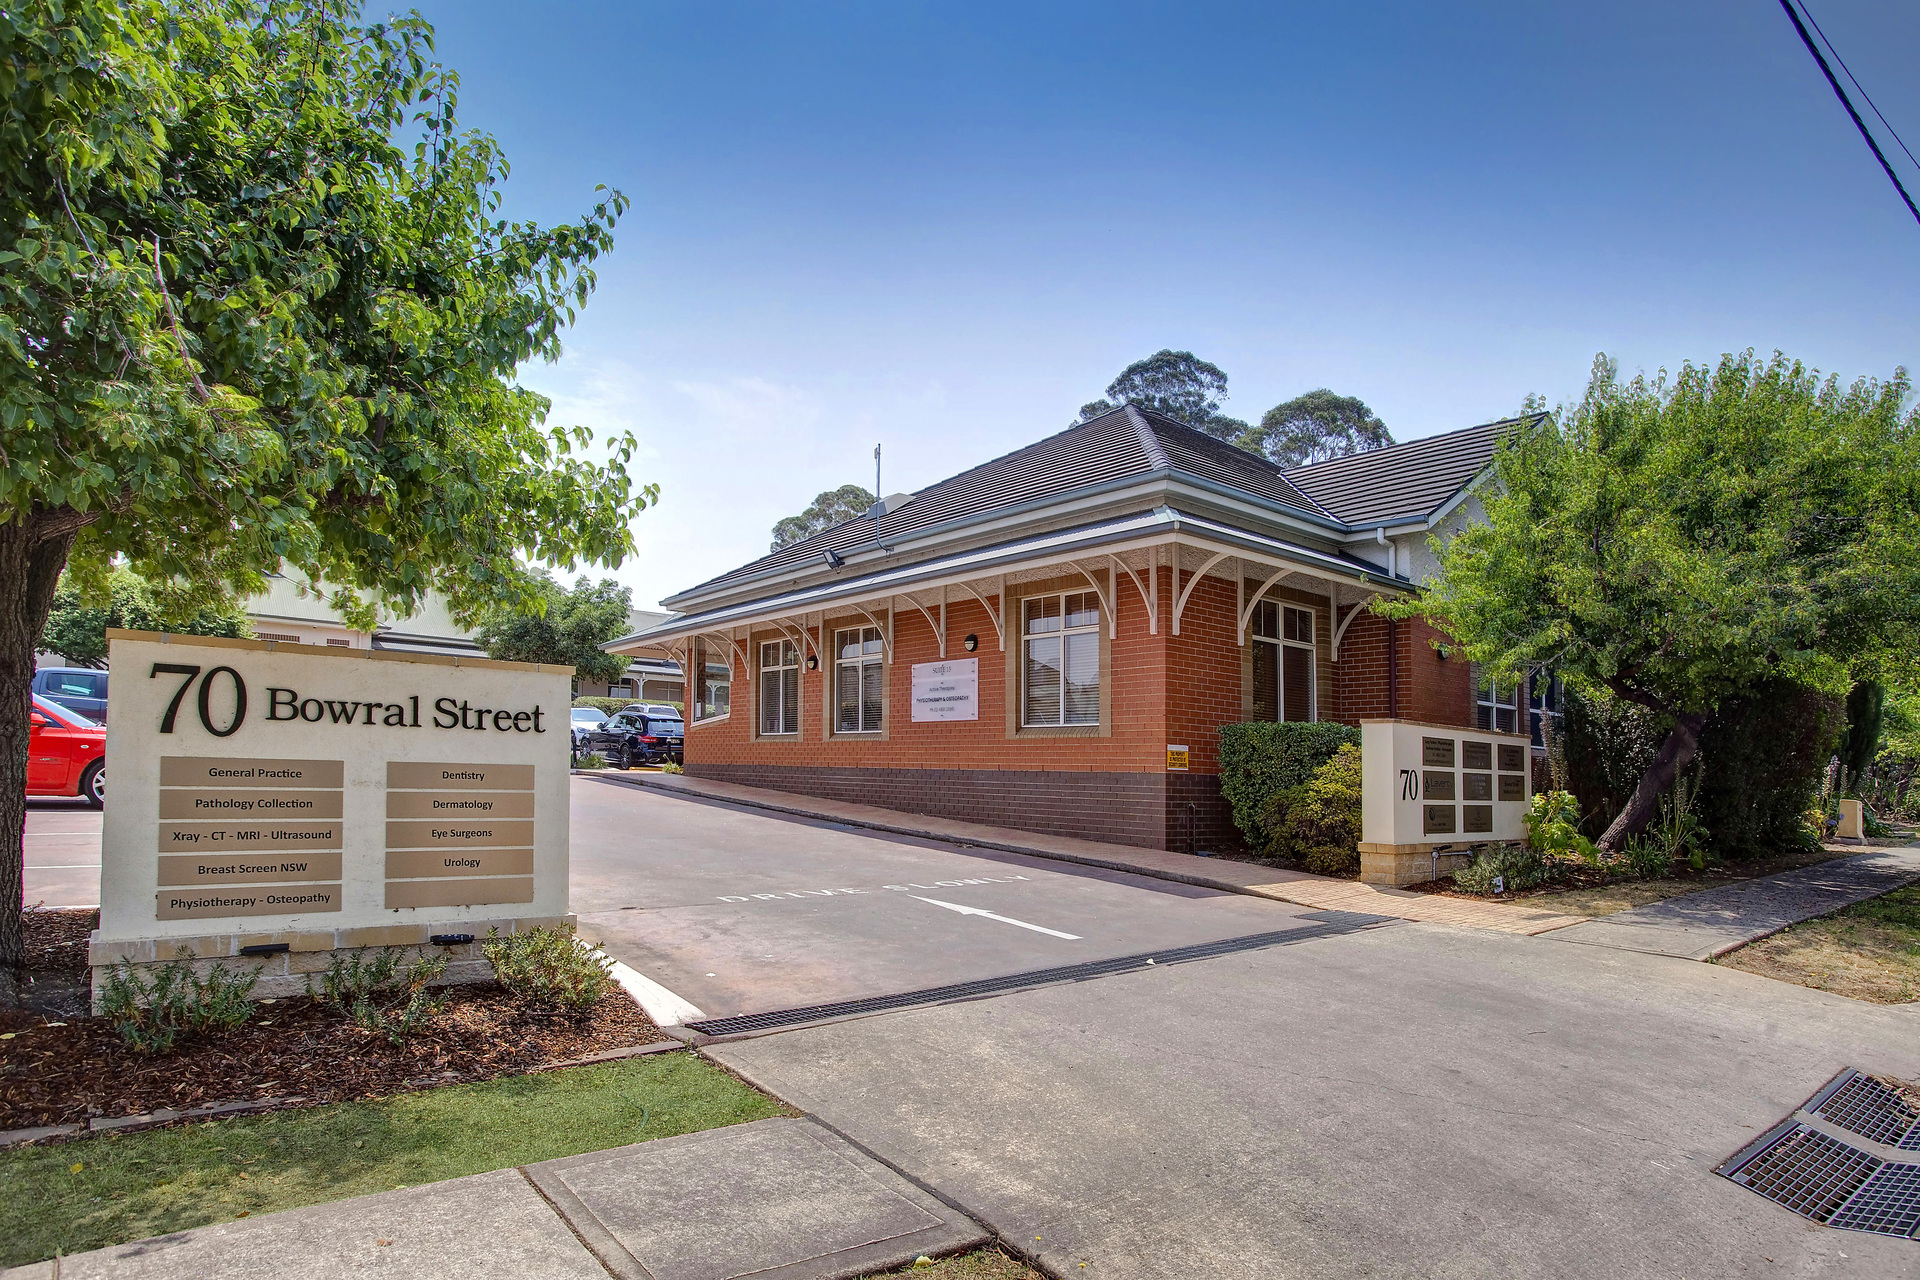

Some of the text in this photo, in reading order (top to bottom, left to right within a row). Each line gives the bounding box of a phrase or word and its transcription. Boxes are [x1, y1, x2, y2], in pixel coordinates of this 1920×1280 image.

[149, 662, 546, 737] 70 Bowral Street
[208, 767, 303, 779] General Practice
[442, 770, 485, 782] Dentistry
[1399, 769, 1418, 801] 70
[195, 798, 313, 811] Pathology Collection
[432, 799, 494, 811] Dermatology
[172, 831, 201, 844] Xray
[211, 831, 227, 841] CT
[236, 830, 261, 841] MRI
[270, 829, 332, 841] Ultrasound
[431, 828, 493, 841] Eye Surgeons
[197, 862, 308, 875] Breast Screen NSW
[444, 857, 481, 869] Urology
[716, 875, 1032, 903] DRIVE SLOWLY
[170, 896, 257, 911] Physiotherapy
[266, 893, 331, 907] Osteopathy
